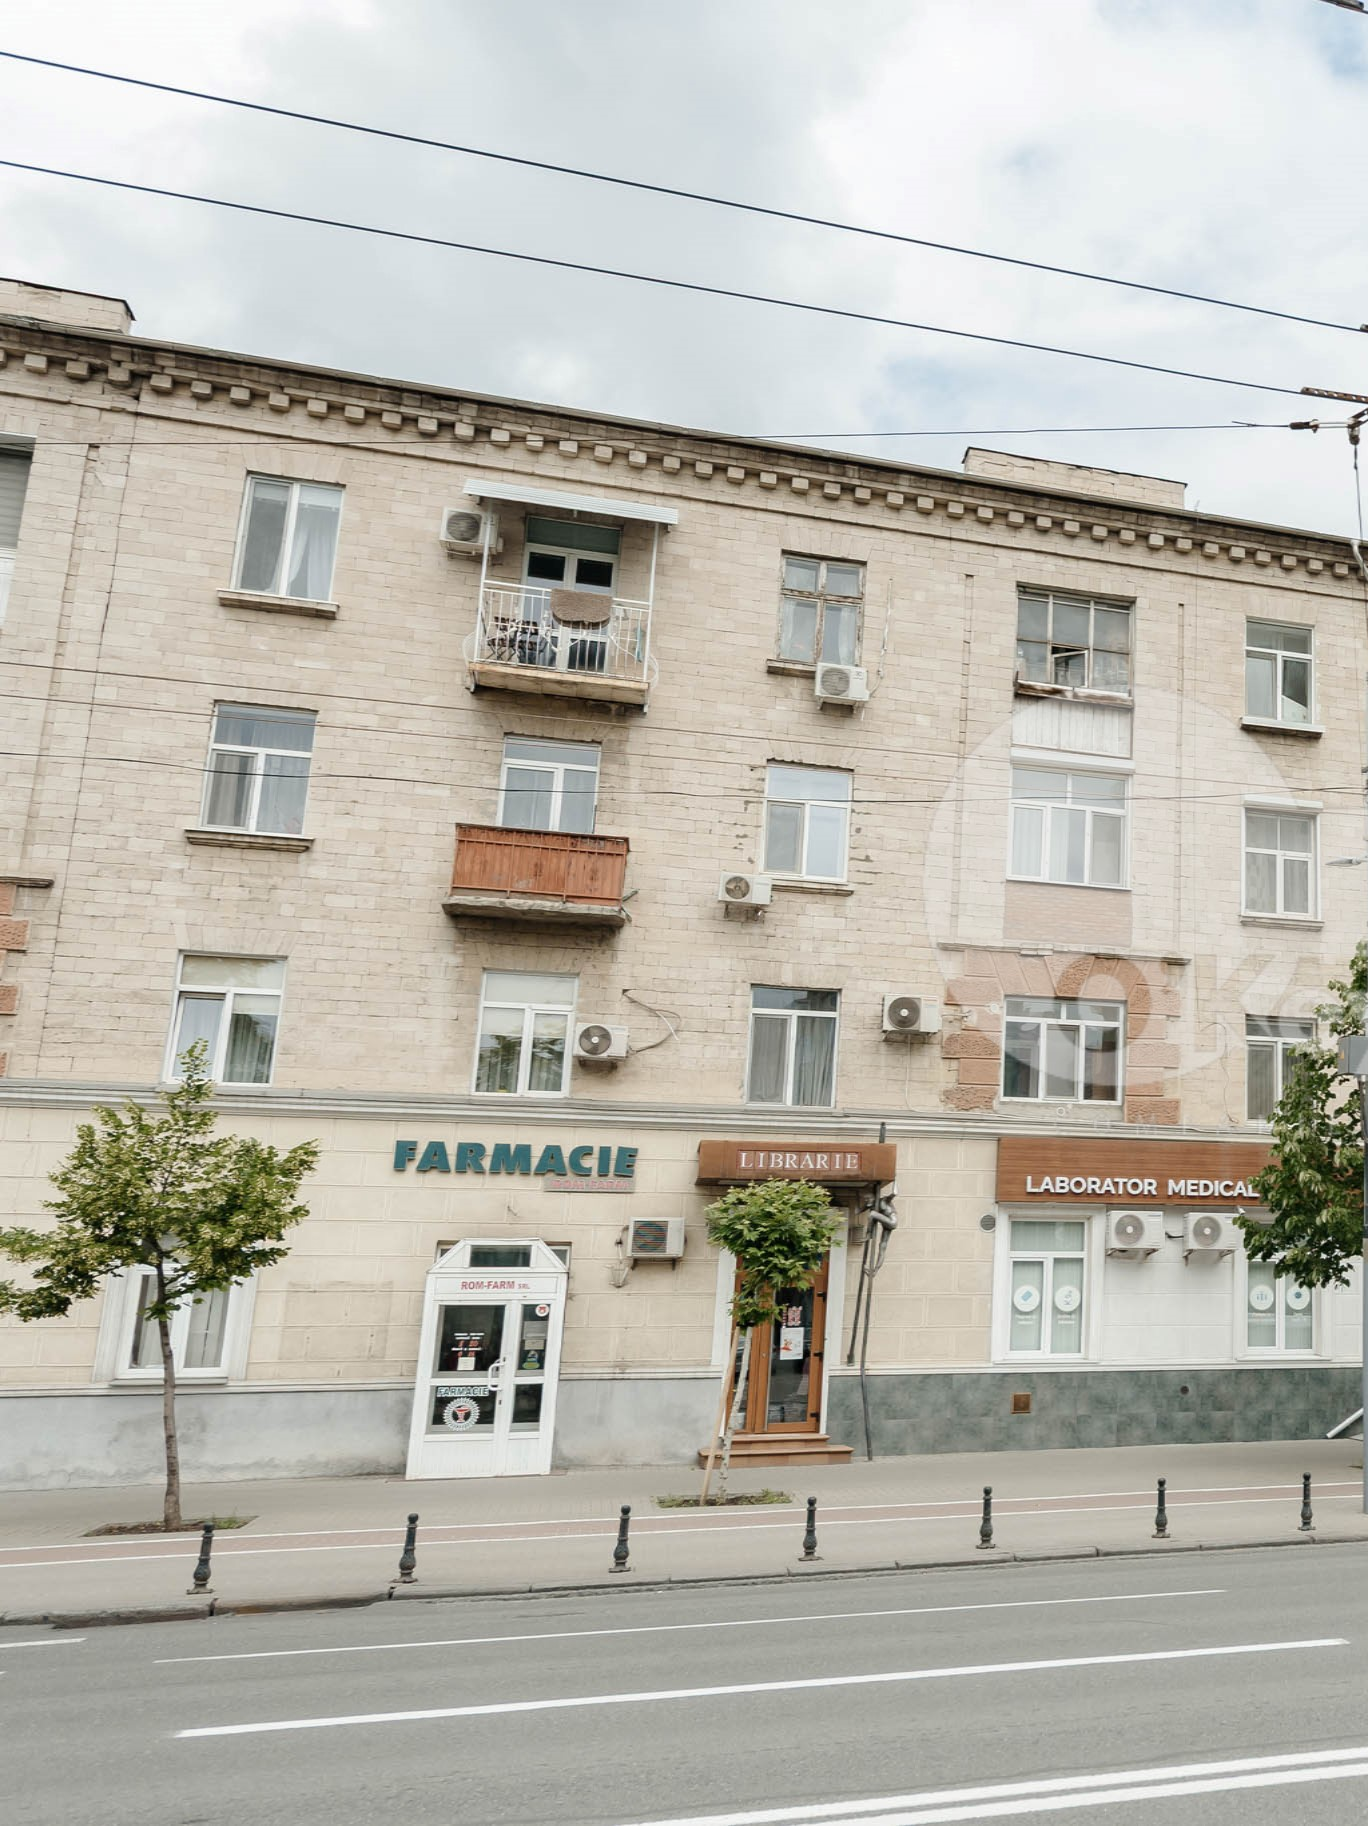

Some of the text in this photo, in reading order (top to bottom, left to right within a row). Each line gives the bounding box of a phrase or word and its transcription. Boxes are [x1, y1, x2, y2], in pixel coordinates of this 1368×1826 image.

[393, 1139, 639, 1177] FARMACIE
[739, 1152, 859, 1169] LIBRARIE
[1025, 1175, 1261, 1198] LABORATOR MEDICAL
[460, 1280, 516, 1291] ROM-FARM
[437, 1385, 490, 1397] FARMACIE
